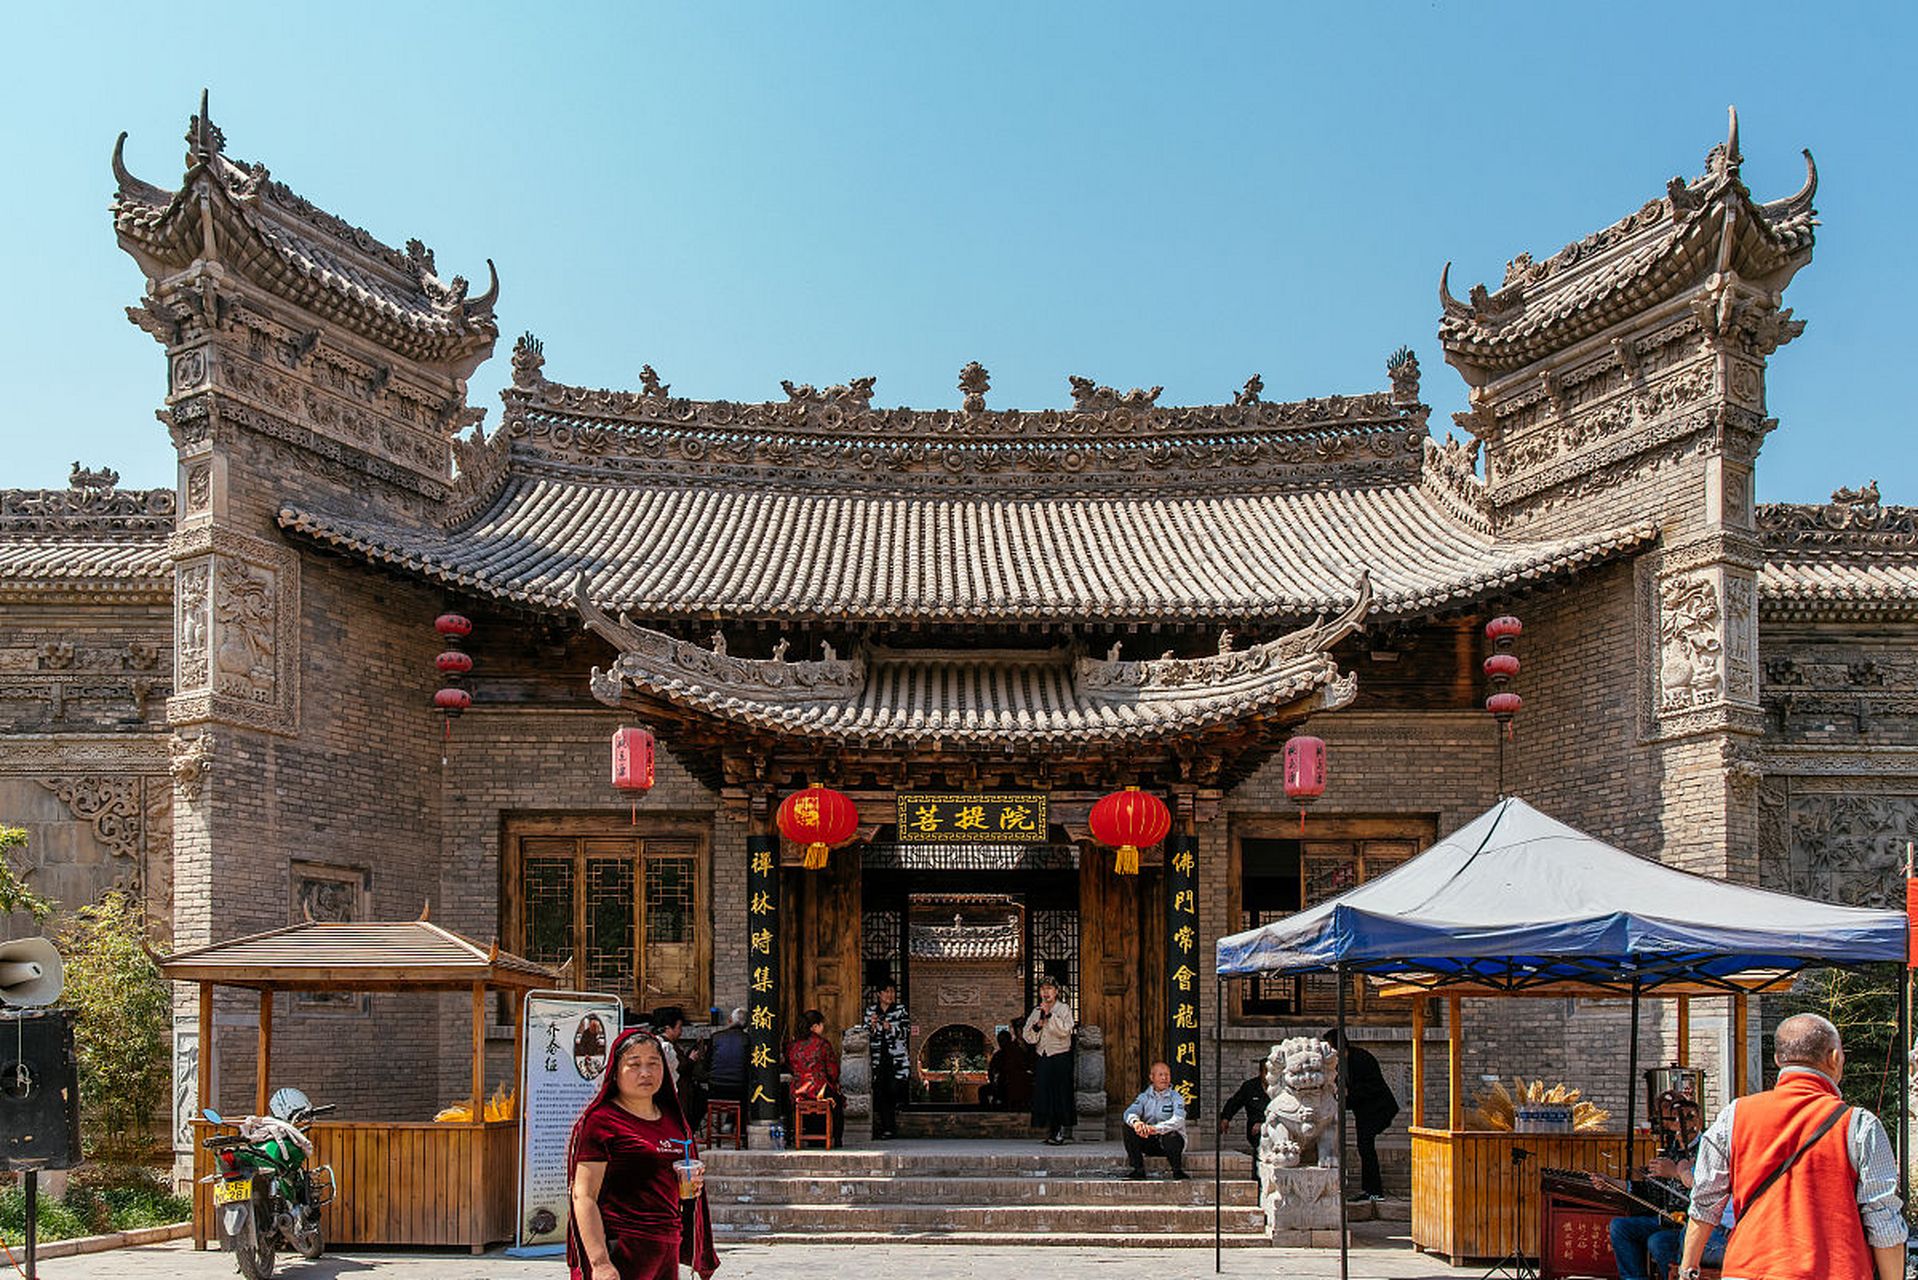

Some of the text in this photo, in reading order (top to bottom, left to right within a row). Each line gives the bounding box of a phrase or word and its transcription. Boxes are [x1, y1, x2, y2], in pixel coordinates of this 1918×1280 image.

[910, 805, 1035, 832] 菩提院
[750, 851, 776, 1103] 禪林時集翰林人
[1172, 850, 1198, 1105] 佛門常會龍門客
